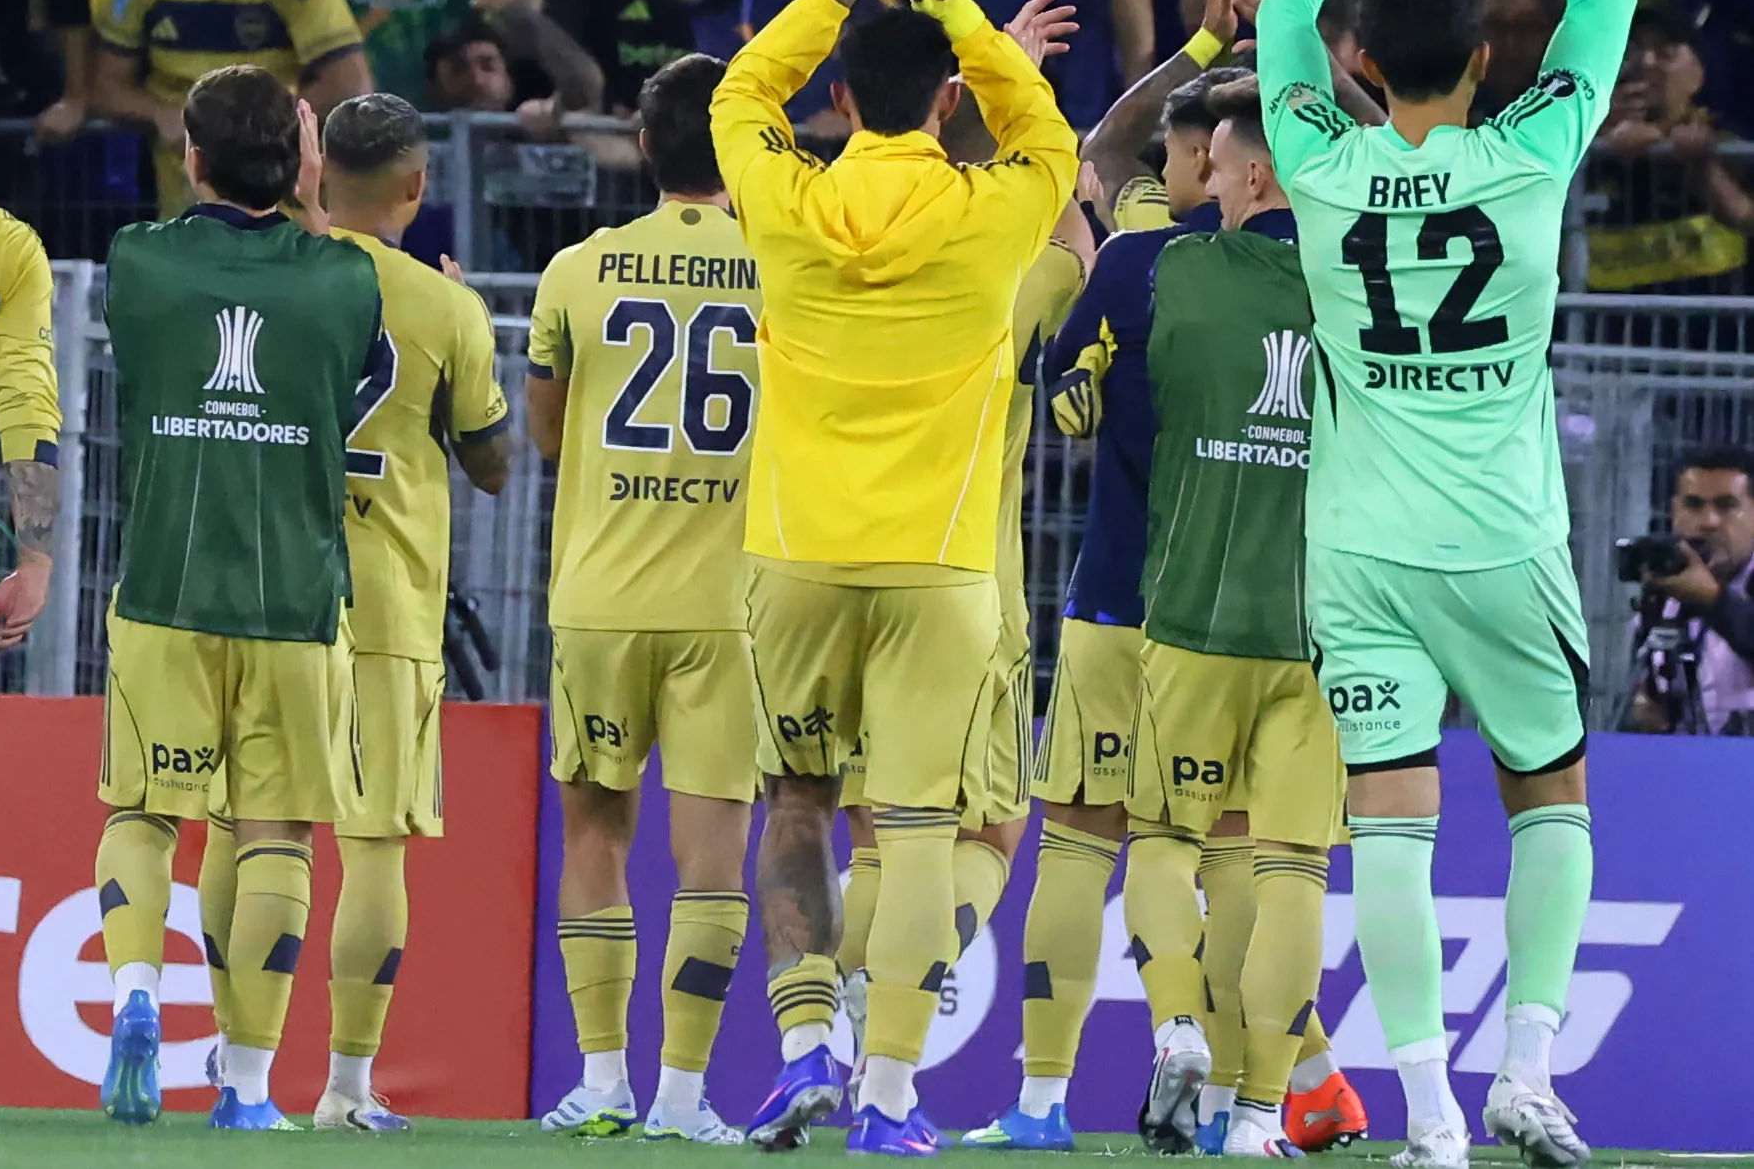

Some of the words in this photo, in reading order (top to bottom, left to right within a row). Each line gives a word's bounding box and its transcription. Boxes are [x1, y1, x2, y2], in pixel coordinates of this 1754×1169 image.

[1368, 171, 1452, 209] BREY
[598, 253, 761, 290] PELLEGRIN
[1341, 203, 1509, 355] 12
[602, 296, 758, 456] 26
[1363, 359, 1514, 393] DIRECTV
[152, 415, 310, 446] LIBERTADORES
[1196, 437, 1311, 470] LIBERTADO
[610, 472, 740, 504] DIRECTV
[1328, 680, 1402, 718] pax
[152, 742, 216, 775] pax
[1172, 754, 1225, 786] pa
